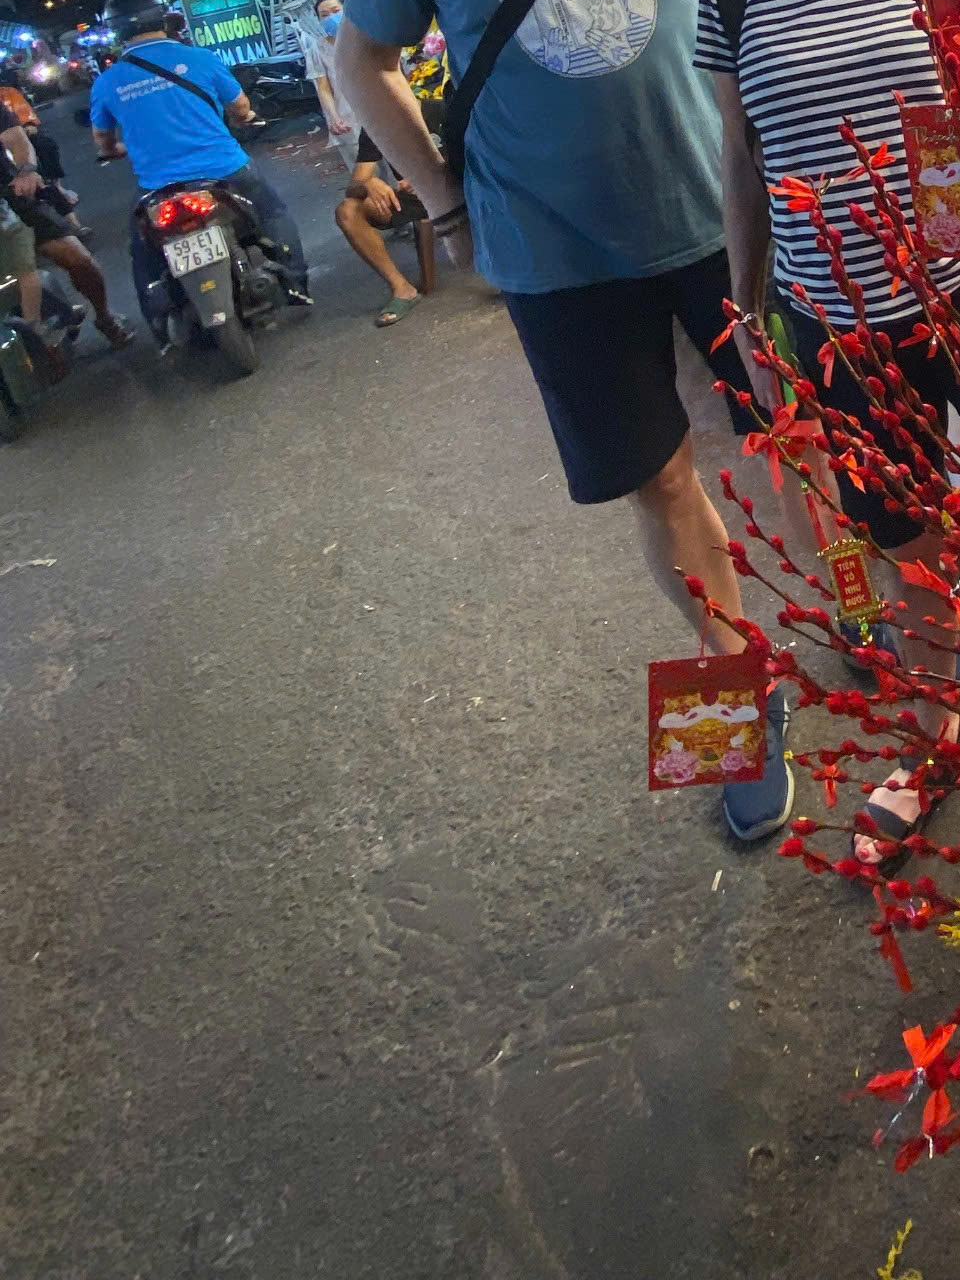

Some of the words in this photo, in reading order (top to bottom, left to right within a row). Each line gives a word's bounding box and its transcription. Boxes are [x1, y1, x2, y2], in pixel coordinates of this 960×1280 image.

[194, 20, 215, 47] GÀ
[213, 13, 262, 43] NƯỚNG
[236, 40, 269, 64] LAM
